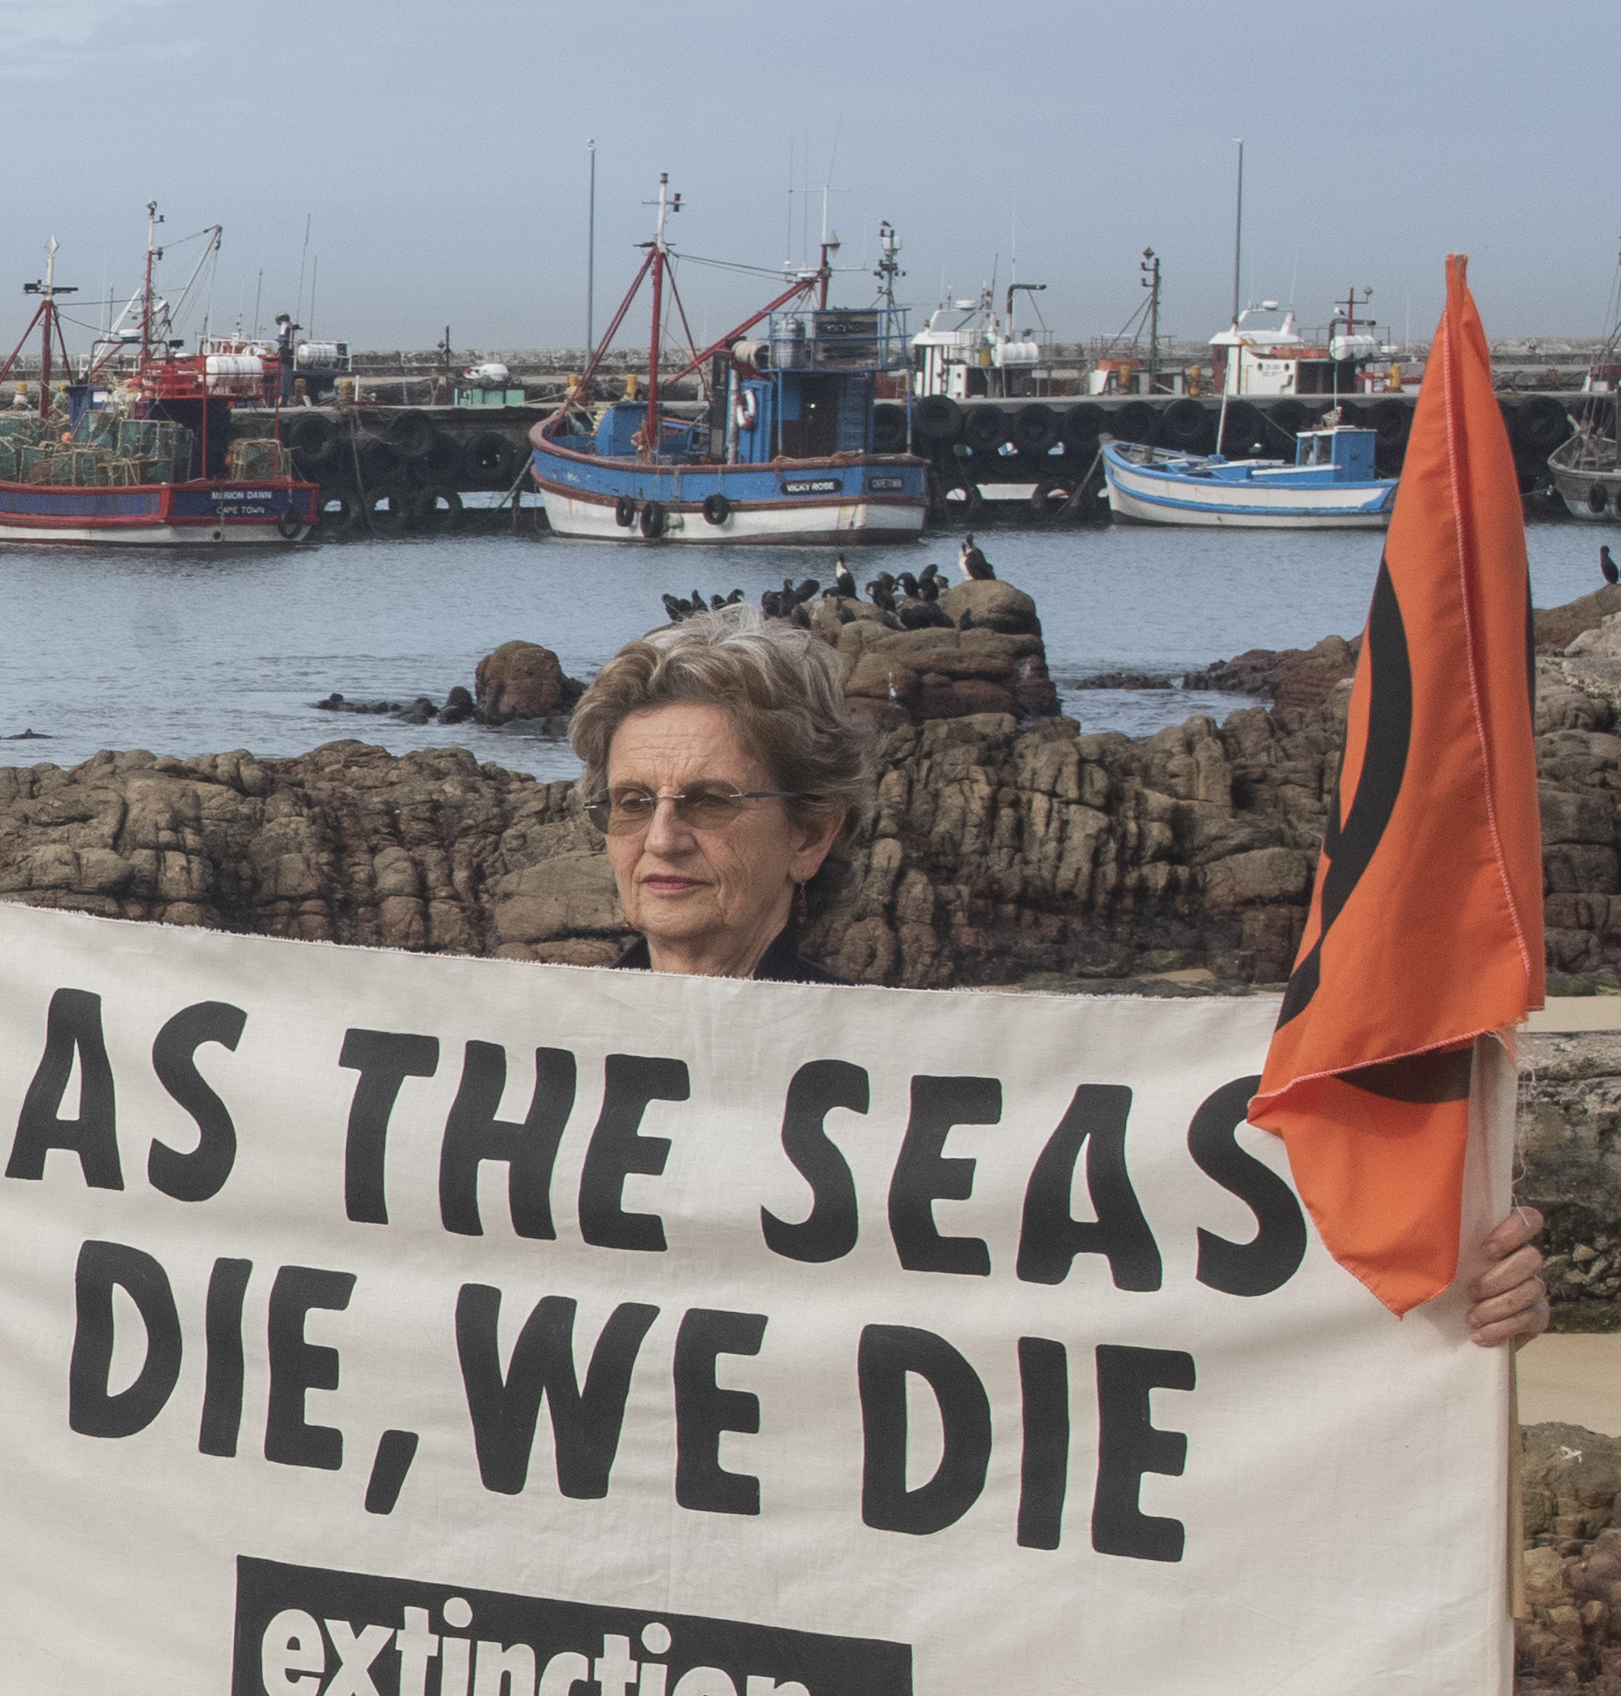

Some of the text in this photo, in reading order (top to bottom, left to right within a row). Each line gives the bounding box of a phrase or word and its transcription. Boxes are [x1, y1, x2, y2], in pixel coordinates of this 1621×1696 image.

[811, 481, 835, 490] ROSE
[246, 491, 272, 499] DAWN
[216, 506, 266, 514] CAPE TOWN
[5, 988, 1307, 1297] AS THE SEAS
[69, 1240, 1196, 1562] DIE, WE DIE
